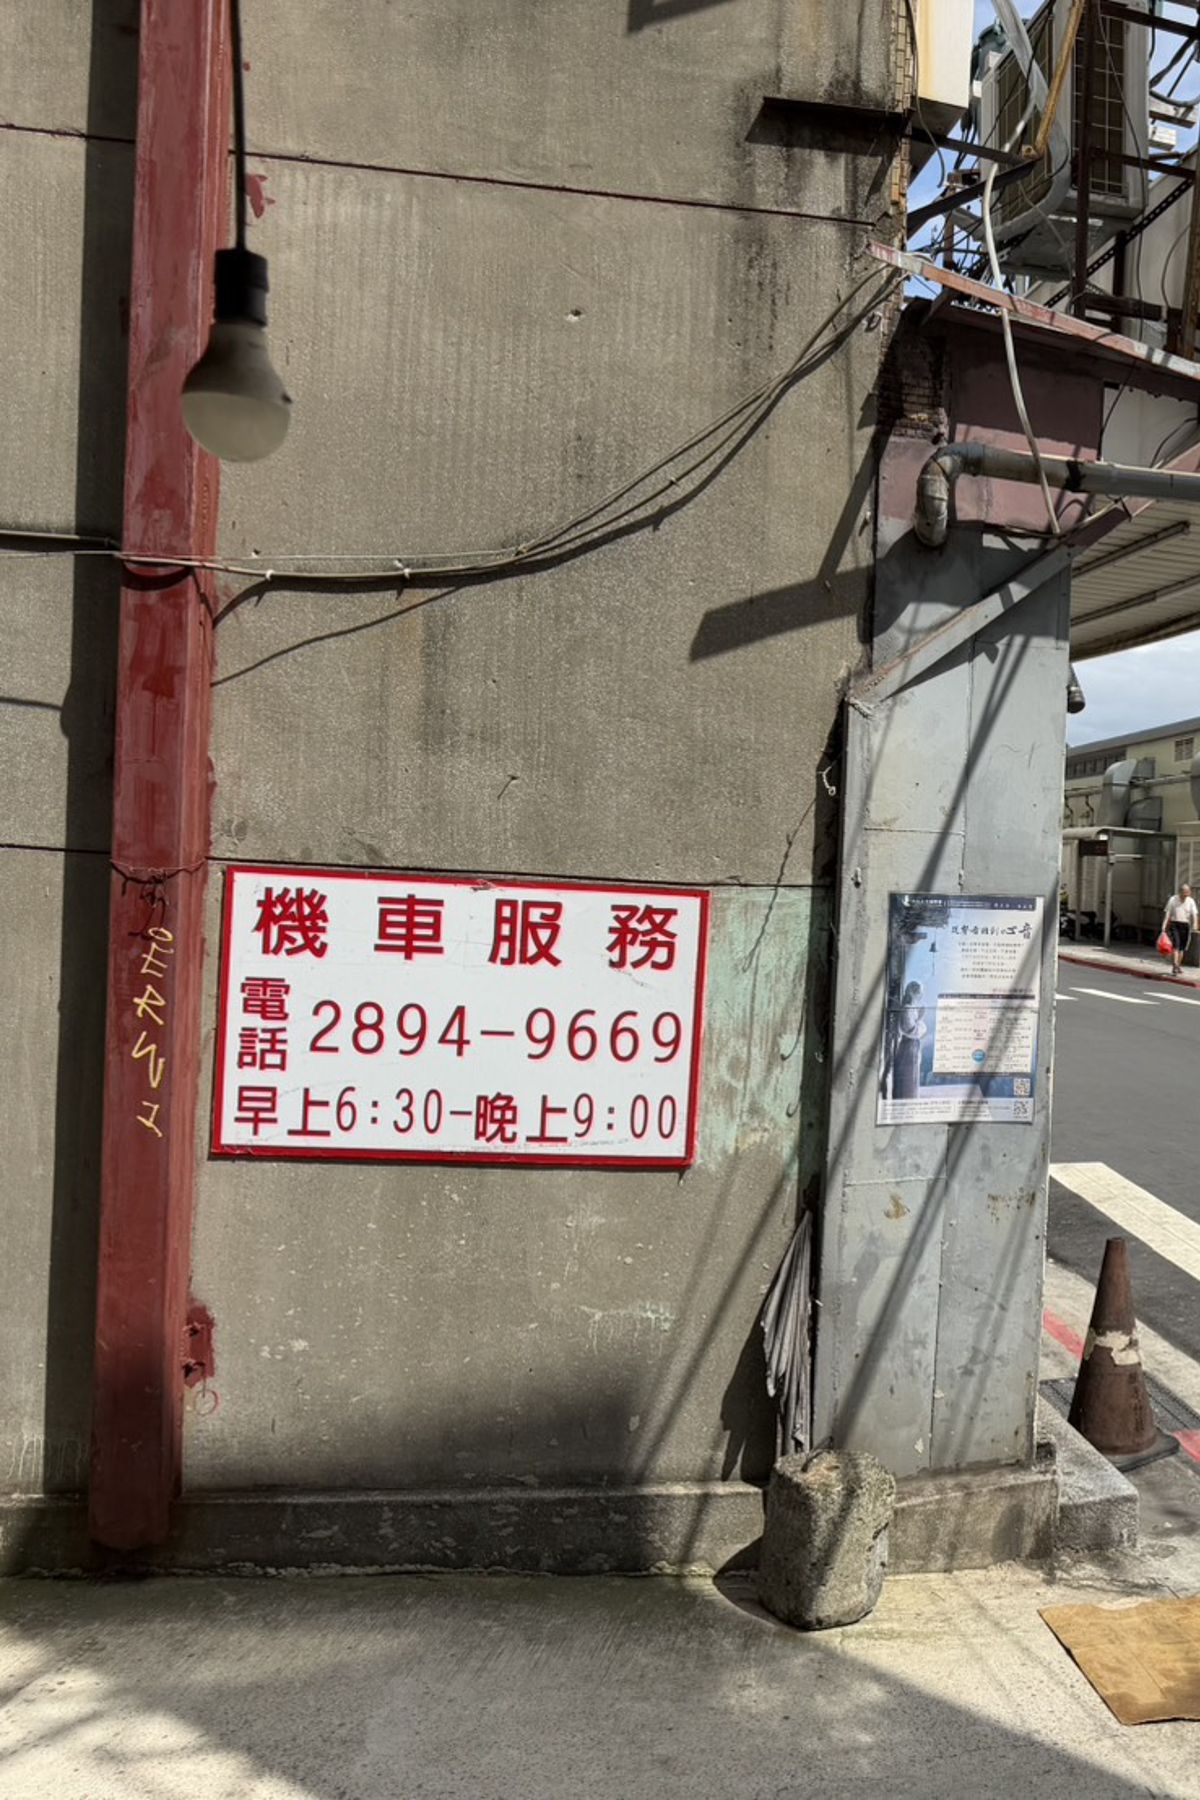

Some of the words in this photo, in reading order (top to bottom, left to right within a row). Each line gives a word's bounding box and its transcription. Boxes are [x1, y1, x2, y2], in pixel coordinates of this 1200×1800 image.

[252, 886, 680, 971] 機車服務
[237, 976, 290, 1072] 電話
[309, 999, 682, 1064] 2894-9669
[234, 1085, 679, 1144] 早上6:30-晚上9:00
